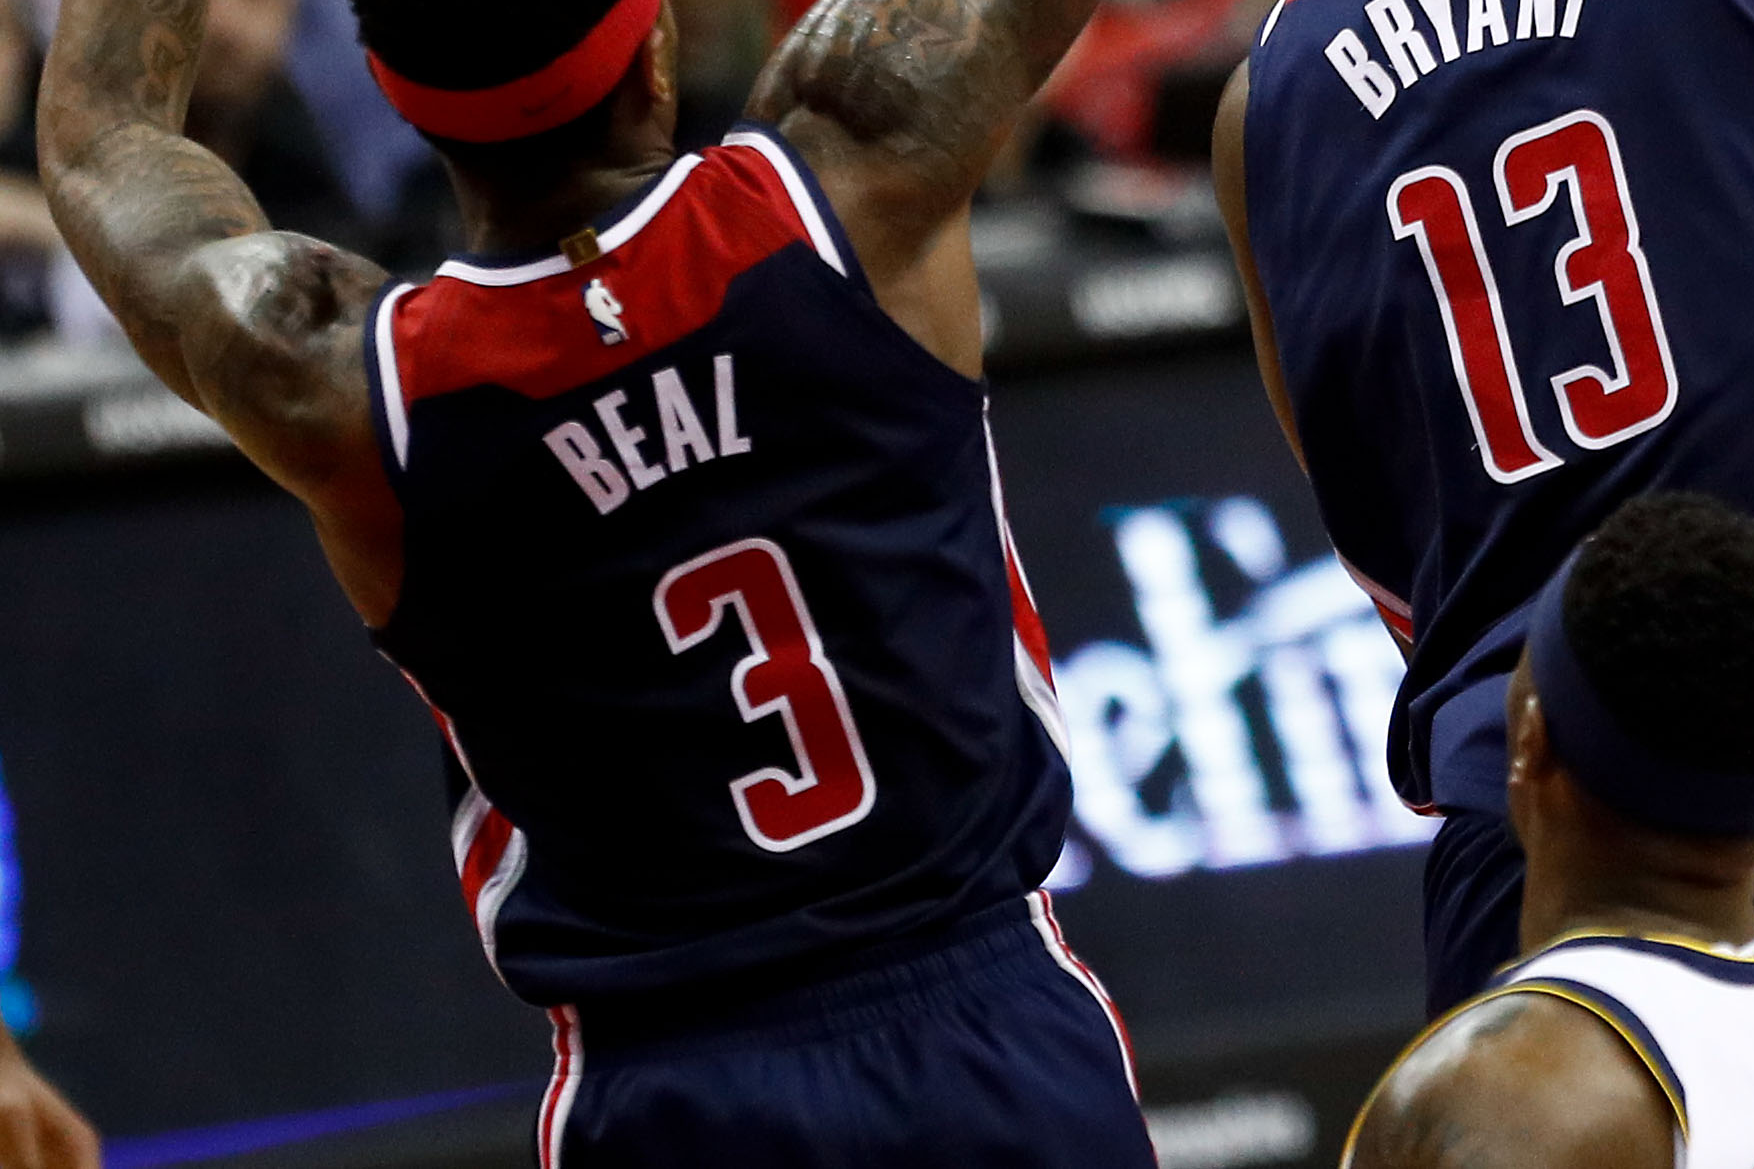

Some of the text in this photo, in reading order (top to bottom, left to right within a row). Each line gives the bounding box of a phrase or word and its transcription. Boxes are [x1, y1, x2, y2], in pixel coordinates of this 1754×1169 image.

[542, 353, 752, 515] BEAL
[1386, 109, 1678, 484] 13
[653, 537, 876, 852] 3
